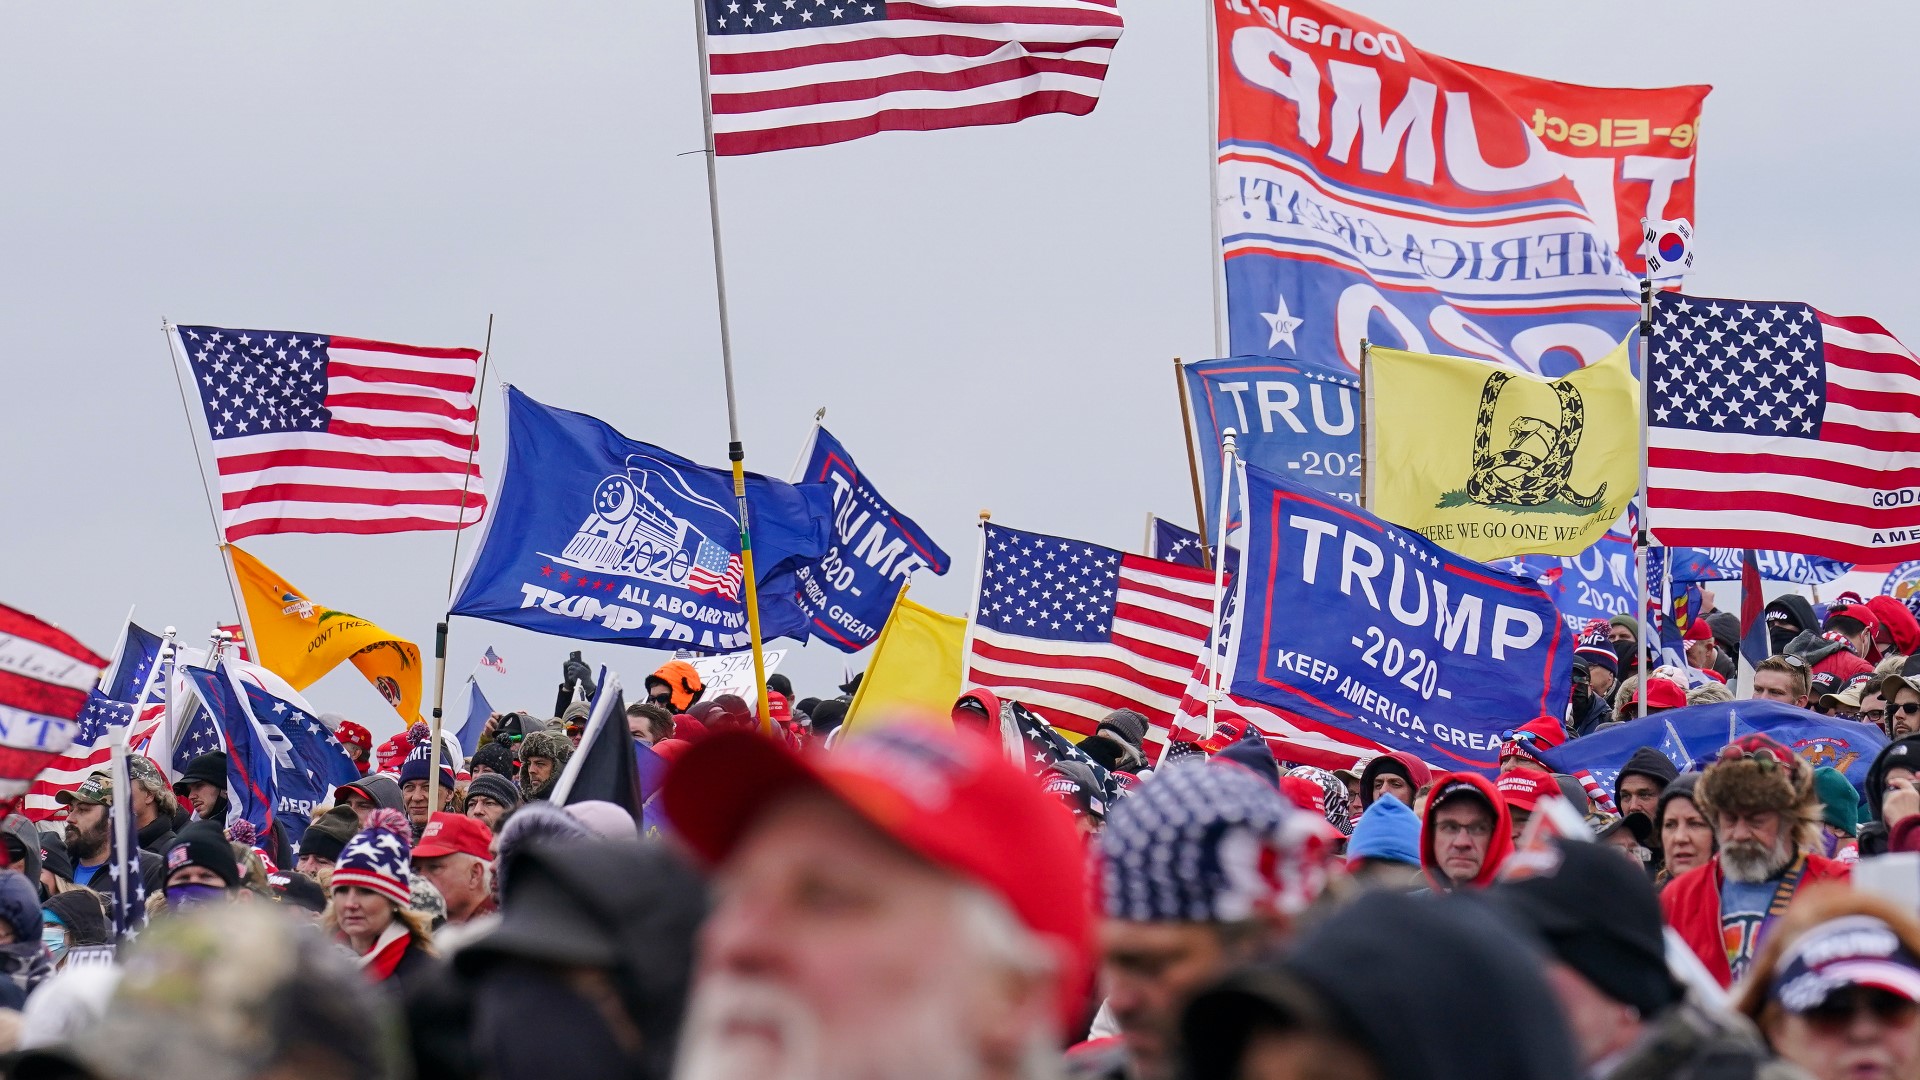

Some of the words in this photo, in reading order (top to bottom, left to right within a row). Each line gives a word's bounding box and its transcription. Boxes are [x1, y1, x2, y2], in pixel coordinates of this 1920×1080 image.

[1218, 380, 1355, 436] TRU
[1288, 451, 1361, 476] -202
[1873, 489, 1914, 507] GOD
[1457, 522, 1479, 538] WE
[1483, 522, 1506, 538] GO
[1511, 523, 1548, 541] ONE
[1554, 526, 1579, 541] WE
[1872, 529, 1920, 544] AME
[618, 539, 691, 583] 2020
[618, 584, 651, 606] ALL
[656, 593, 720, 625] ABOARD
[1289, 514, 1543, 661] TRUMP
[1577, 580, 1630, 615] 2020
[520, 582, 644, 632] TRUMP
[829, 605, 876, 642] GREAT!
[1766, 610, 1787, 620] RUMP
[308, 627, 335, 653] DONT
[1352, 626, 1452, 700] -2020-
[1277, 649, 1339, 685] KEEP
[1336, 675, 1428, 734] AMERICA
[1433, 722, 1502, 751] GREA
